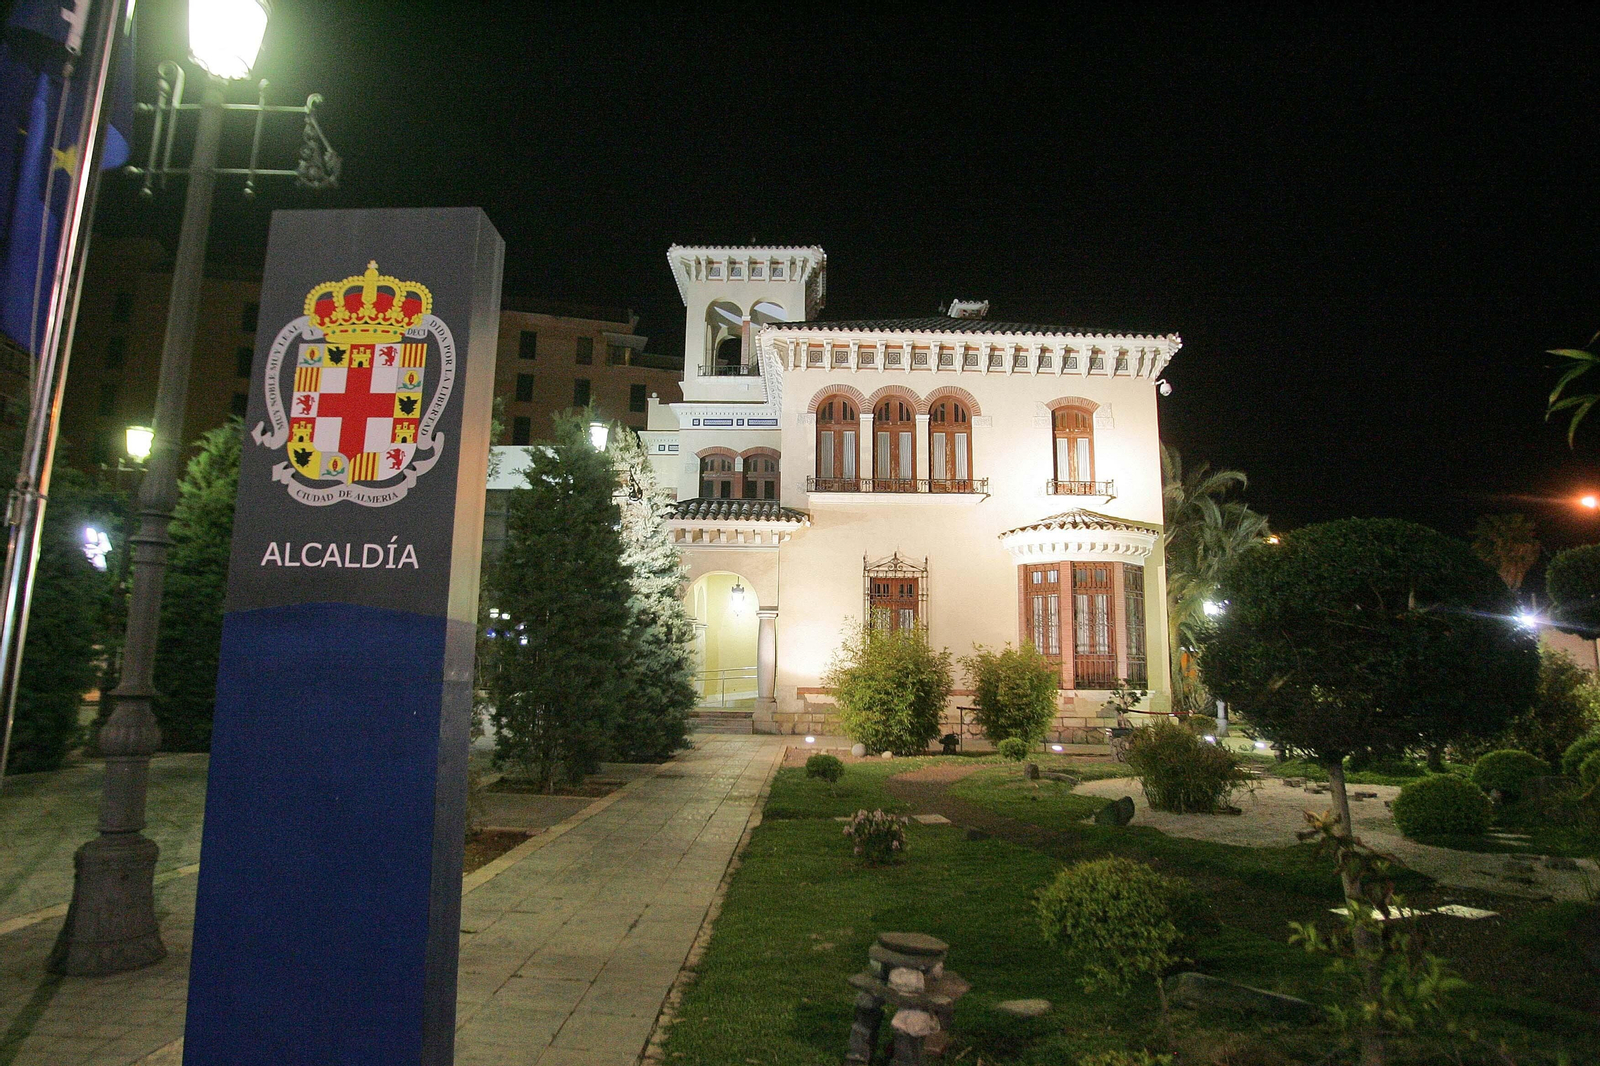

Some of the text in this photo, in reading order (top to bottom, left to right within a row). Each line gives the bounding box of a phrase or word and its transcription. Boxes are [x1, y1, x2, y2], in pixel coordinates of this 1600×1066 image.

[278, 325, 298, 347] LEAL
[406, 328, 427, 336] DECI
[429, 320, 448, 343] DIDA
[270, 349, 281, 370] MUY
[443, 345, 453, 366] POR
[443, 369, 453, 382] LA
[268, 375, 277, 407] NOBLE
[273, 410, 285, 430] MUY
[420, 386, 449, 436] LIBERTAD
[296, 489, 399, 503] CIUDAD DE ALMERIA
[260, 535, 419, 569] ALCALDÍA
